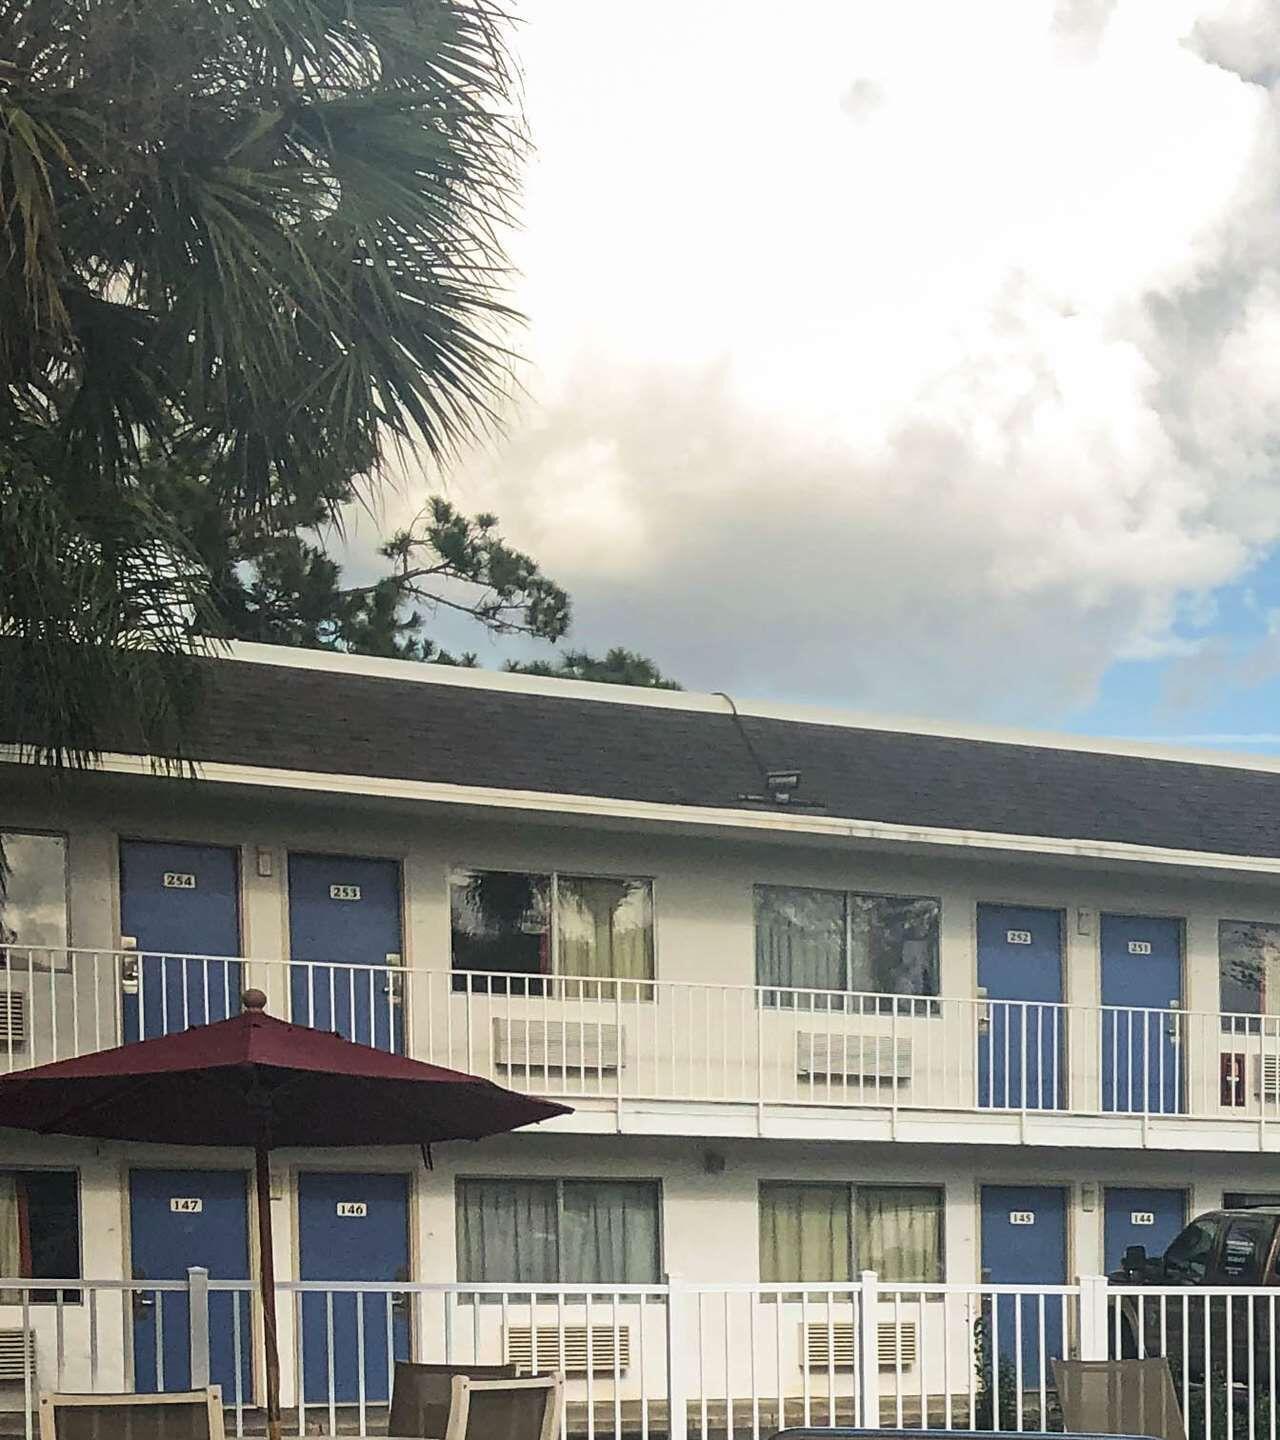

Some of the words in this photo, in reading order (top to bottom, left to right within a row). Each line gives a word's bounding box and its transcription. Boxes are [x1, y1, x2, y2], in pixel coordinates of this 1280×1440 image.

[166, 875, 193, 887] 254
[333, 887, 358, 898] 253
[1010, 932, 1029, 943] 252
[1130, 943, 1149, 953] 251
[173, 1200, 199, 1211] 147
[340, 1205, 364, 1215] 146
[1013, 1213, 1032, 1223] 145
[1134, 1214, 1152, 1224] 144
